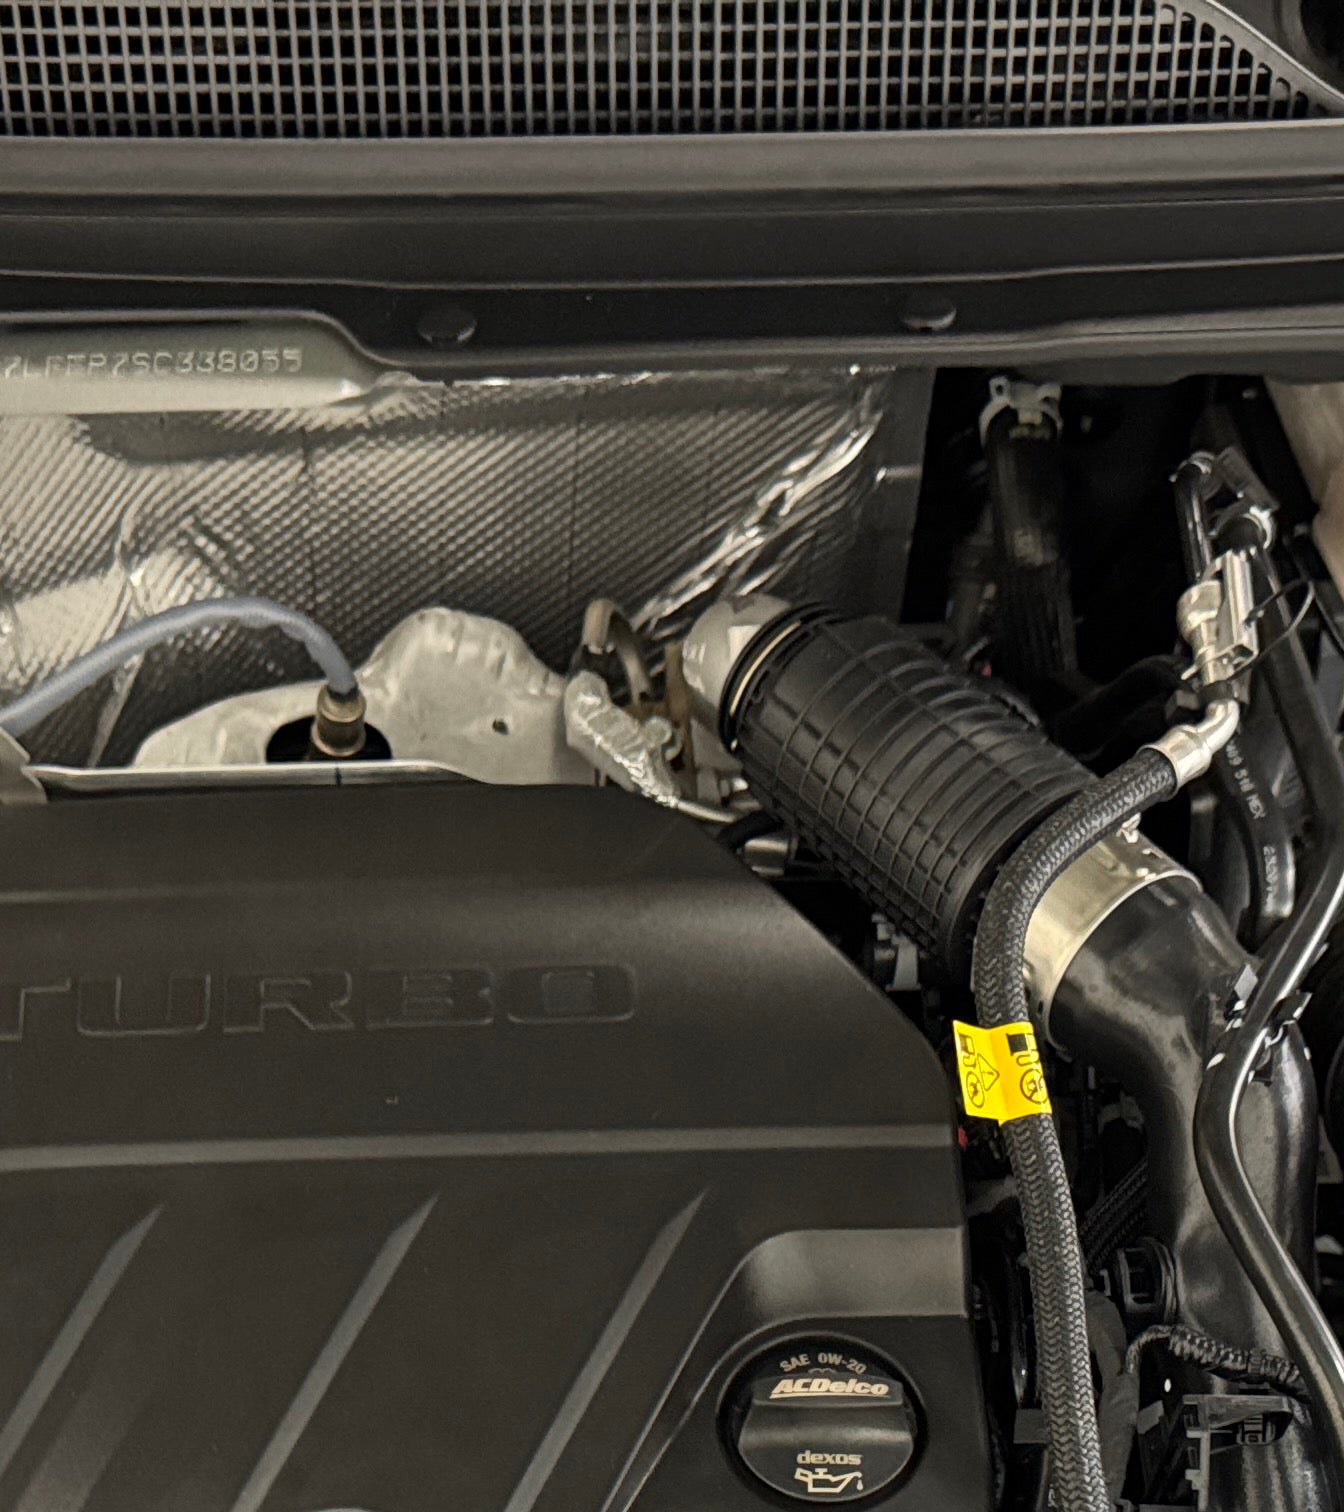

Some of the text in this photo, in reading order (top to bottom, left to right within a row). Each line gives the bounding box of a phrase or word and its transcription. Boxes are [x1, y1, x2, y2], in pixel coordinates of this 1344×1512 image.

[779, 1352, 867, 1375] SAE 0W-20
[770, 1378, 890, 1397] ACDelco
[796, 1449, 863, 1466] dexos
